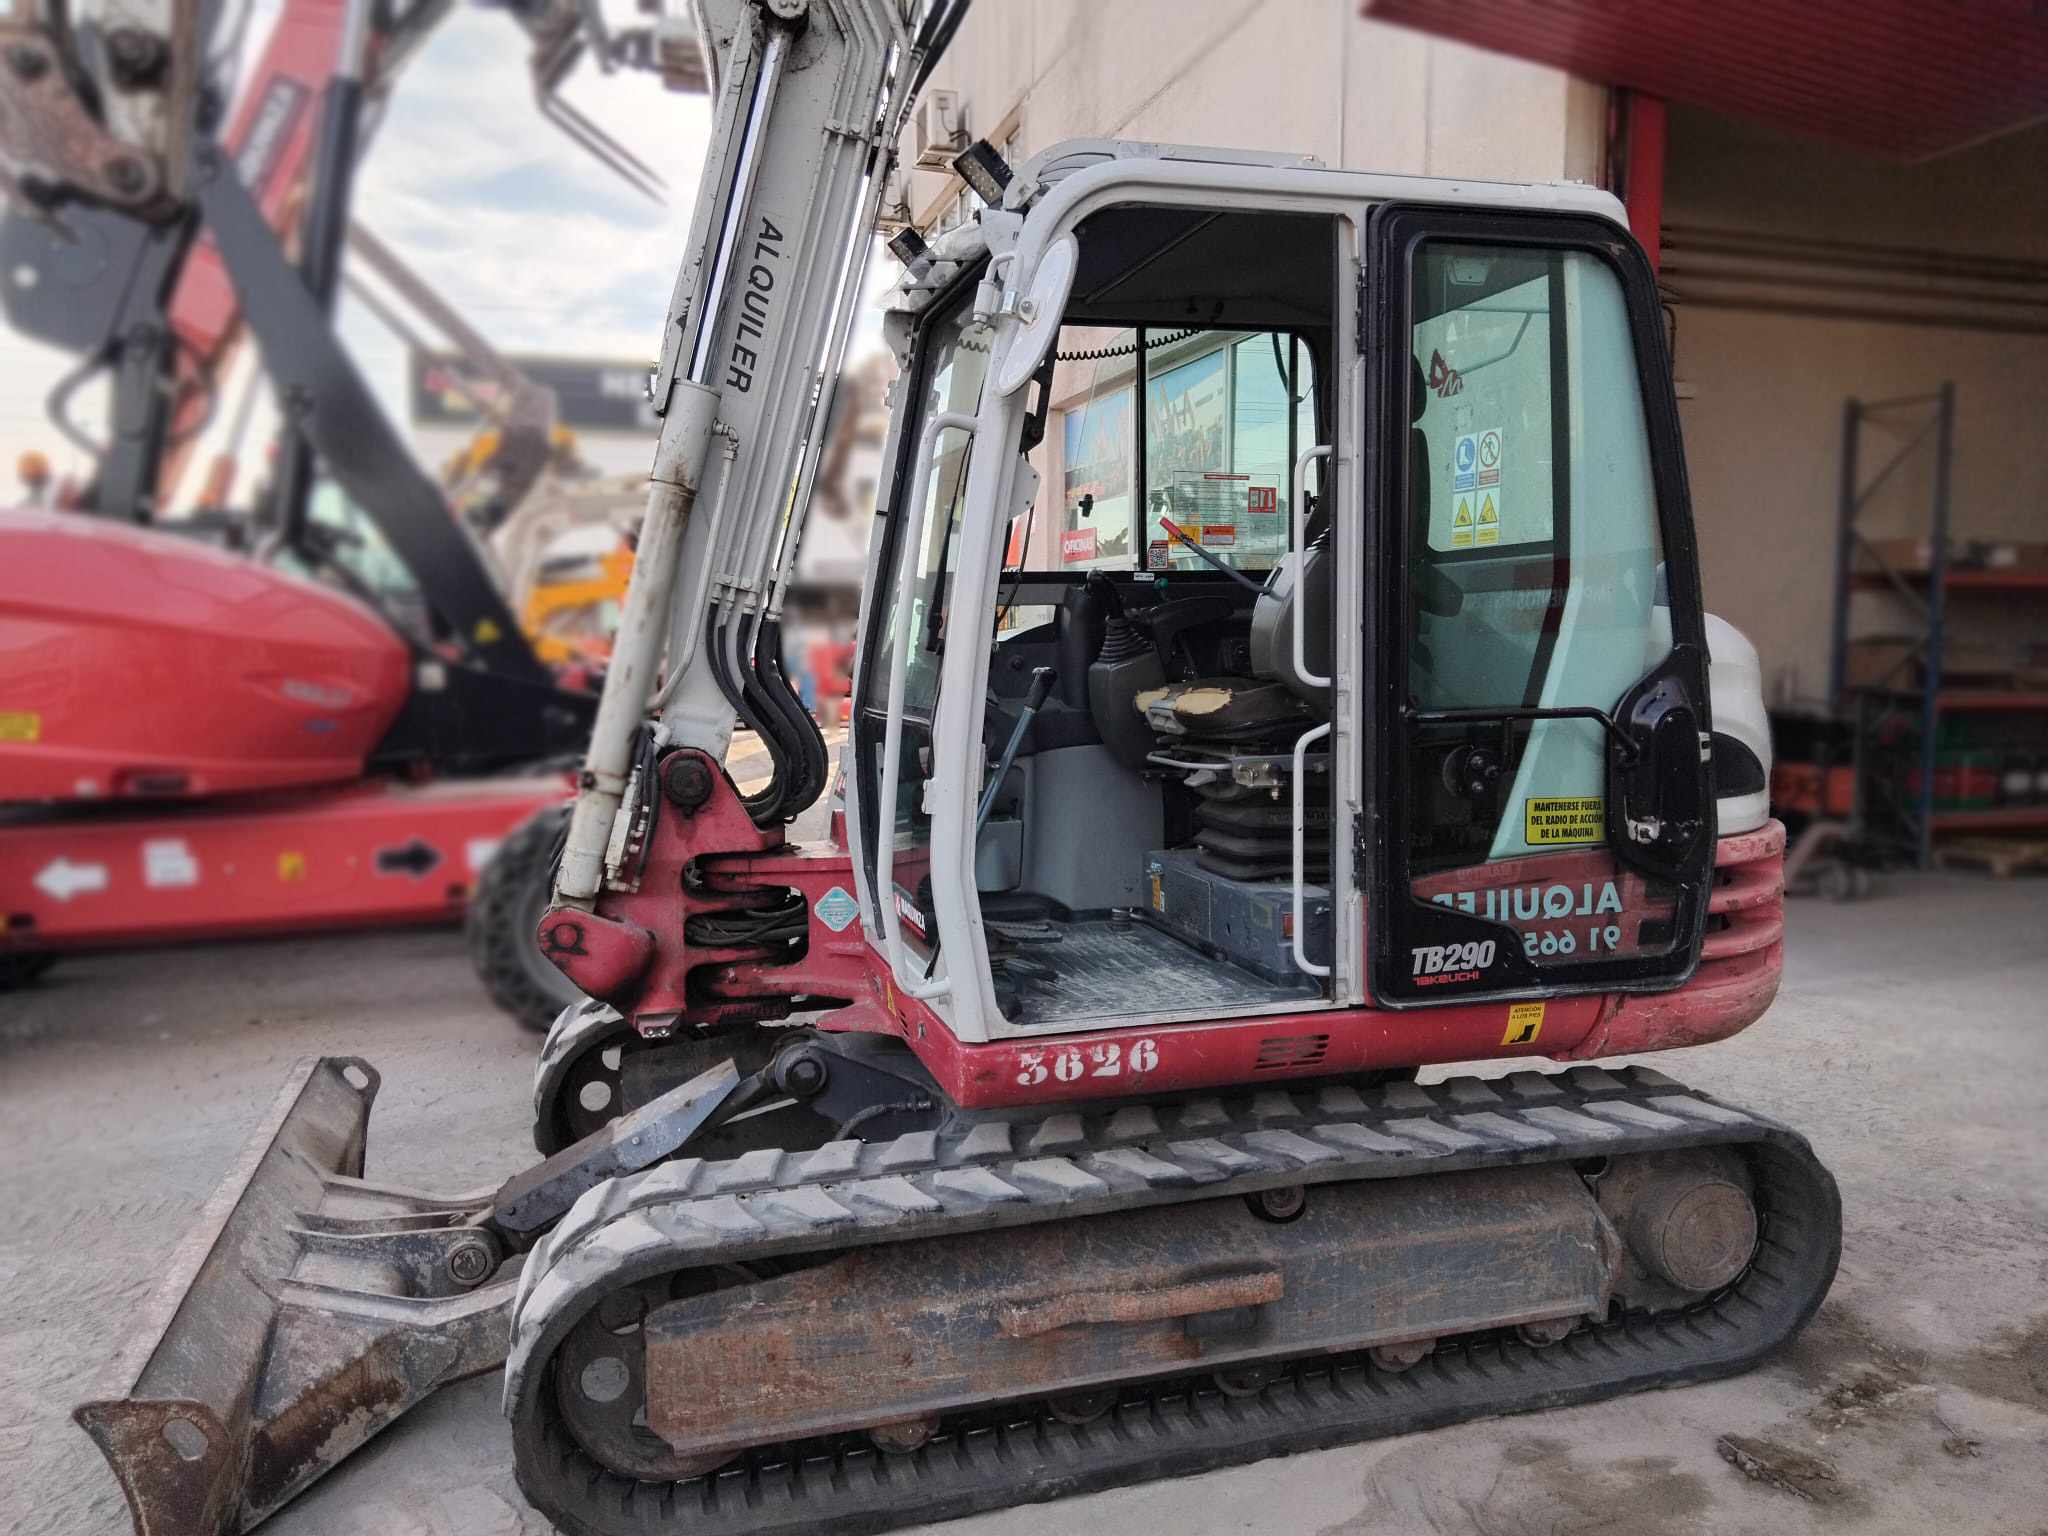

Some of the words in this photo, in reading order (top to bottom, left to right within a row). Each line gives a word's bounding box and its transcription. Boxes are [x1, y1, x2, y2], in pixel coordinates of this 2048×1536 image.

[726, 216, 783, 393] ALQUILER
[1534, 801, 1579, 812] MANTENERSE
[1581, 801, 1601, 811] FUERA
[1531, 815, 1543, 825] DEL
[1545, 815, 1568, 825] RADIO
[1569, 815, 1578, 824] DE
[1541, 828, 1549, 838] DE
[1551, 828, 1560, 838] LA
[1562, 825, 1594, 838] MÁQUINA
[1412, 940, 1496, 975] TB290
[1016, 1038, 1159, 1086] 3626
